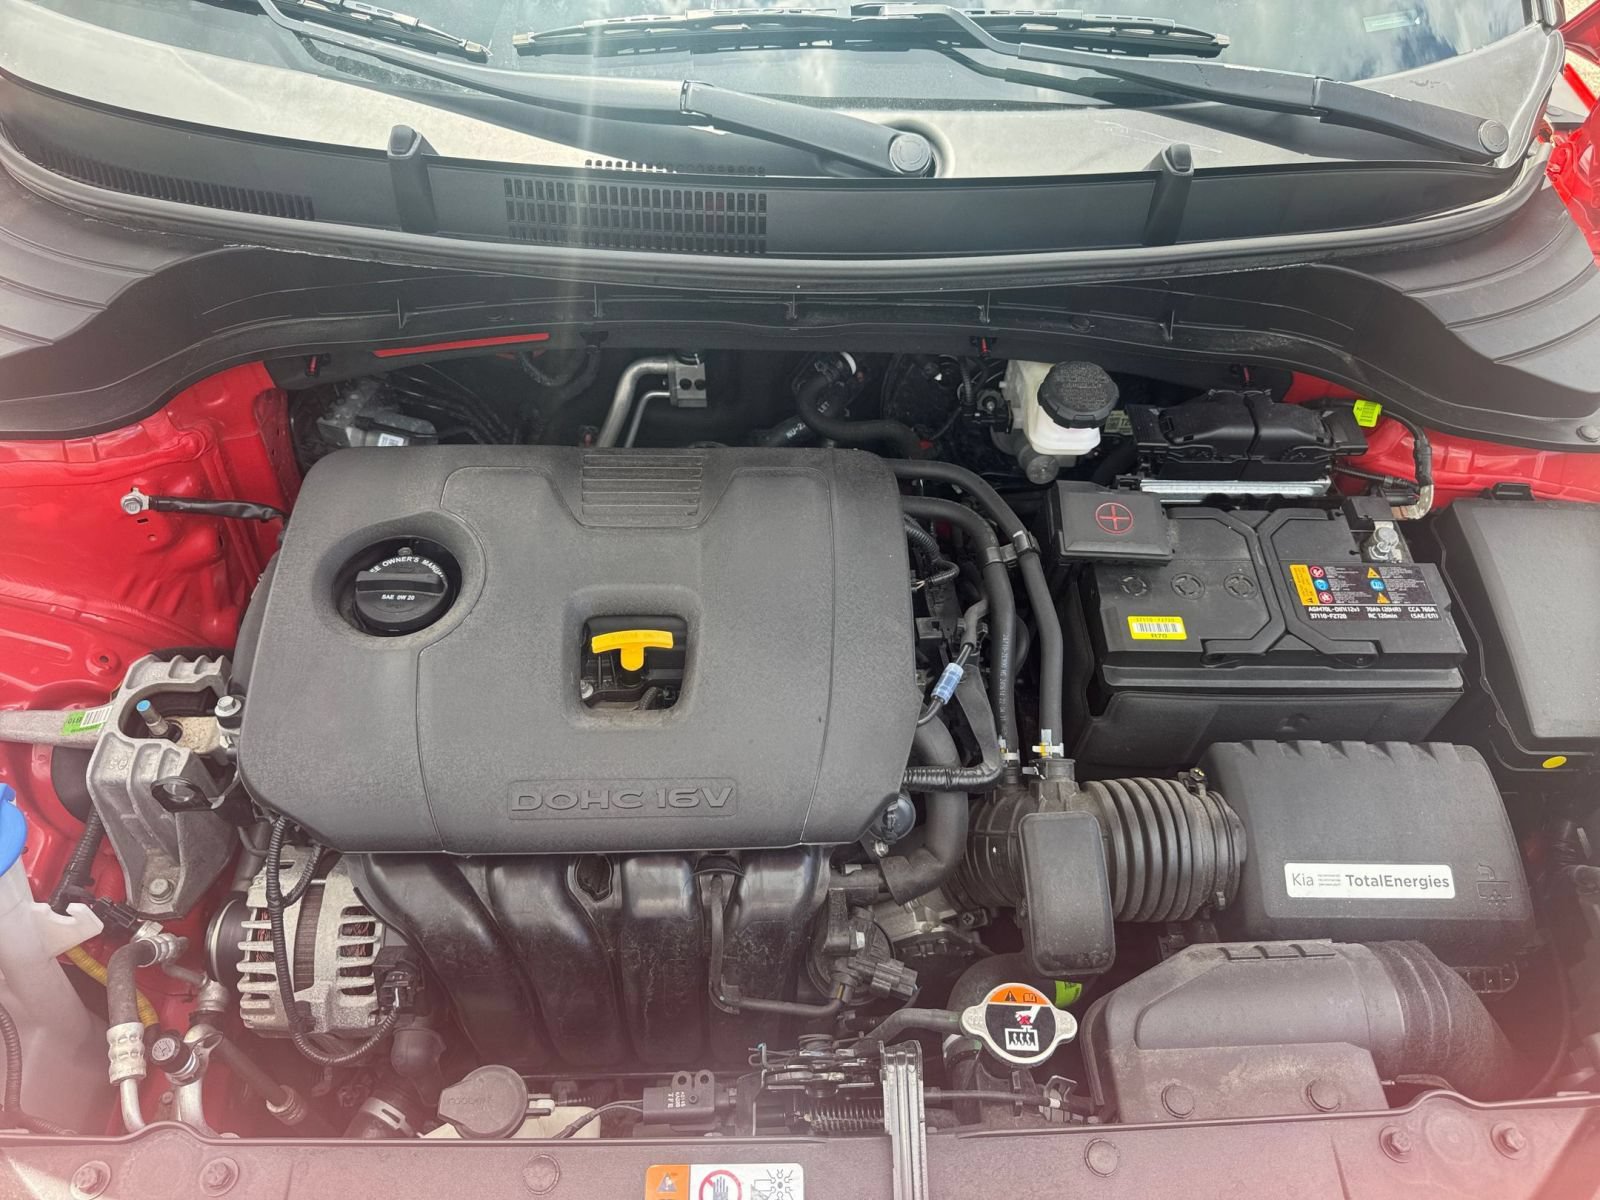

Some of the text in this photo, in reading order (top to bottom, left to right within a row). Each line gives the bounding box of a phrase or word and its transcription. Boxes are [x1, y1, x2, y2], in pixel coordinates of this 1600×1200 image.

[382, 556, 420, 567] OWNER'S
[511, 787, 733, 812] DOHC 16V
[1292, 873, 1450, 890] Kia TotalEnergies
